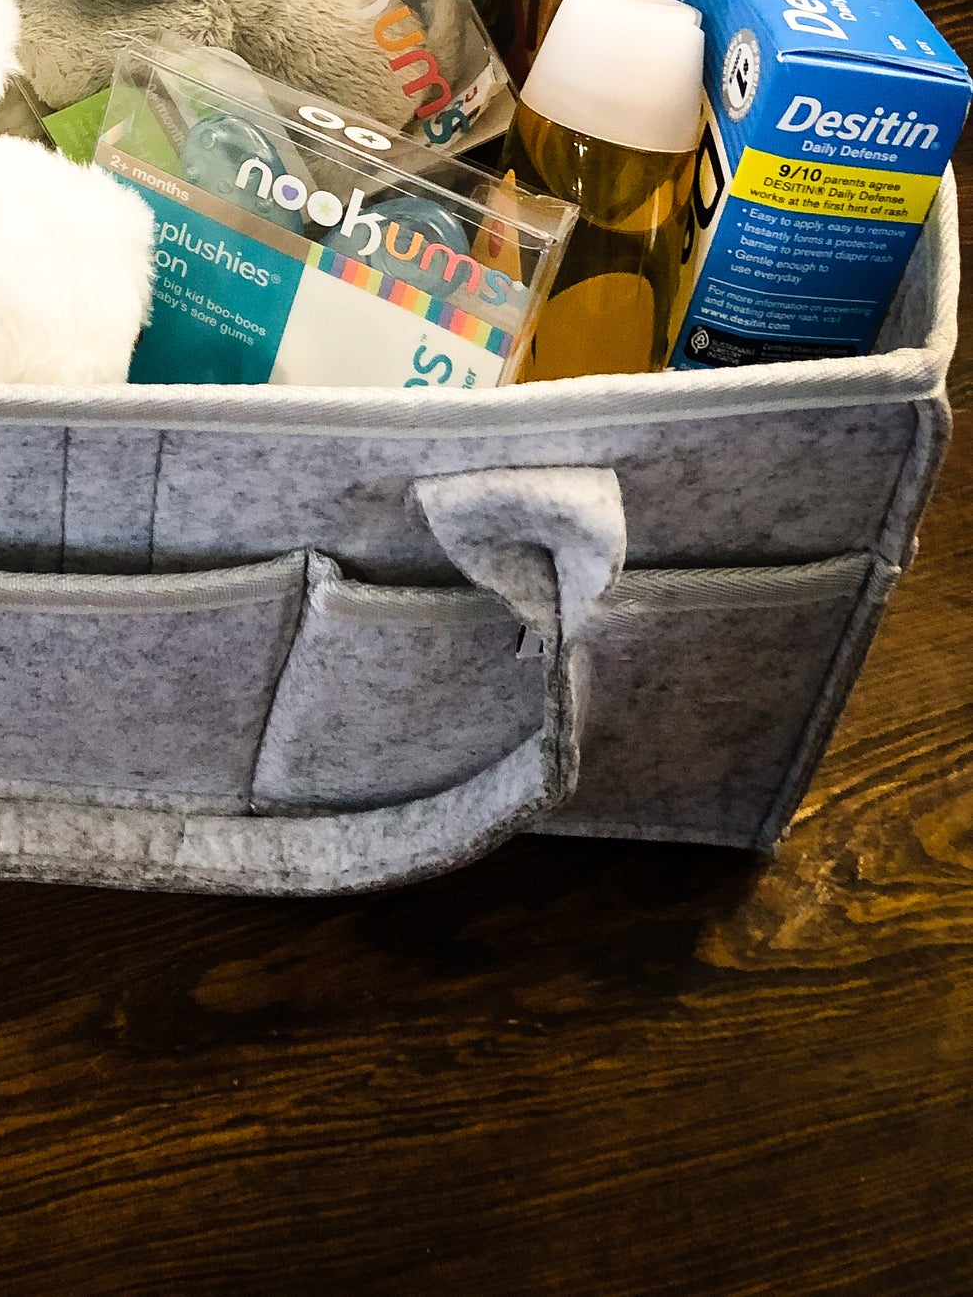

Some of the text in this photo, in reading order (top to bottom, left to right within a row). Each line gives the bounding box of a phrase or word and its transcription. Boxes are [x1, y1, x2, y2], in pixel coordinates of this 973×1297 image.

[802, 140, 898, 163] Daily Defense
[109, 154, 190, 202] 2+ months
[779, 164, 901, 192] 9/10 parents agree
[750, 188, 908, 218] works at the first hint of rash
[828, 188, 856, 202] Daily
[863, 192, 905, 205] Defense
[235, 157, 512, 306] nookums
[744, 222, 792, 244] Instantly
[793, 234, 824, 245] forms
[834, 238, 888, 250] protective
[749, 207, 778, 225] Easy
[780, 216, 792, 227] to
[827, 224, 852, 234] easy
[855, 224, 866, 234] to
[868, 227, 907, 238] remove
[735, 248, 830, 273] Gentle enough to
[740, 235, 894, 263] barrier to prevent diaper rash
[730, 264, 802, 284] use everyday
[163, 277, 182, 296] big
[185, 288, 204, 305] kid
[206, 298, 266, 337] boo-boos
[704, 295, 725, 307] and
[708, 284, 725, 296] For
[727, 292, 753, 304] more
[190, 308, 217, 327] sore
[219, 322, 254, 346] gums
[700, 306, 791, 331] www.desitin.com
